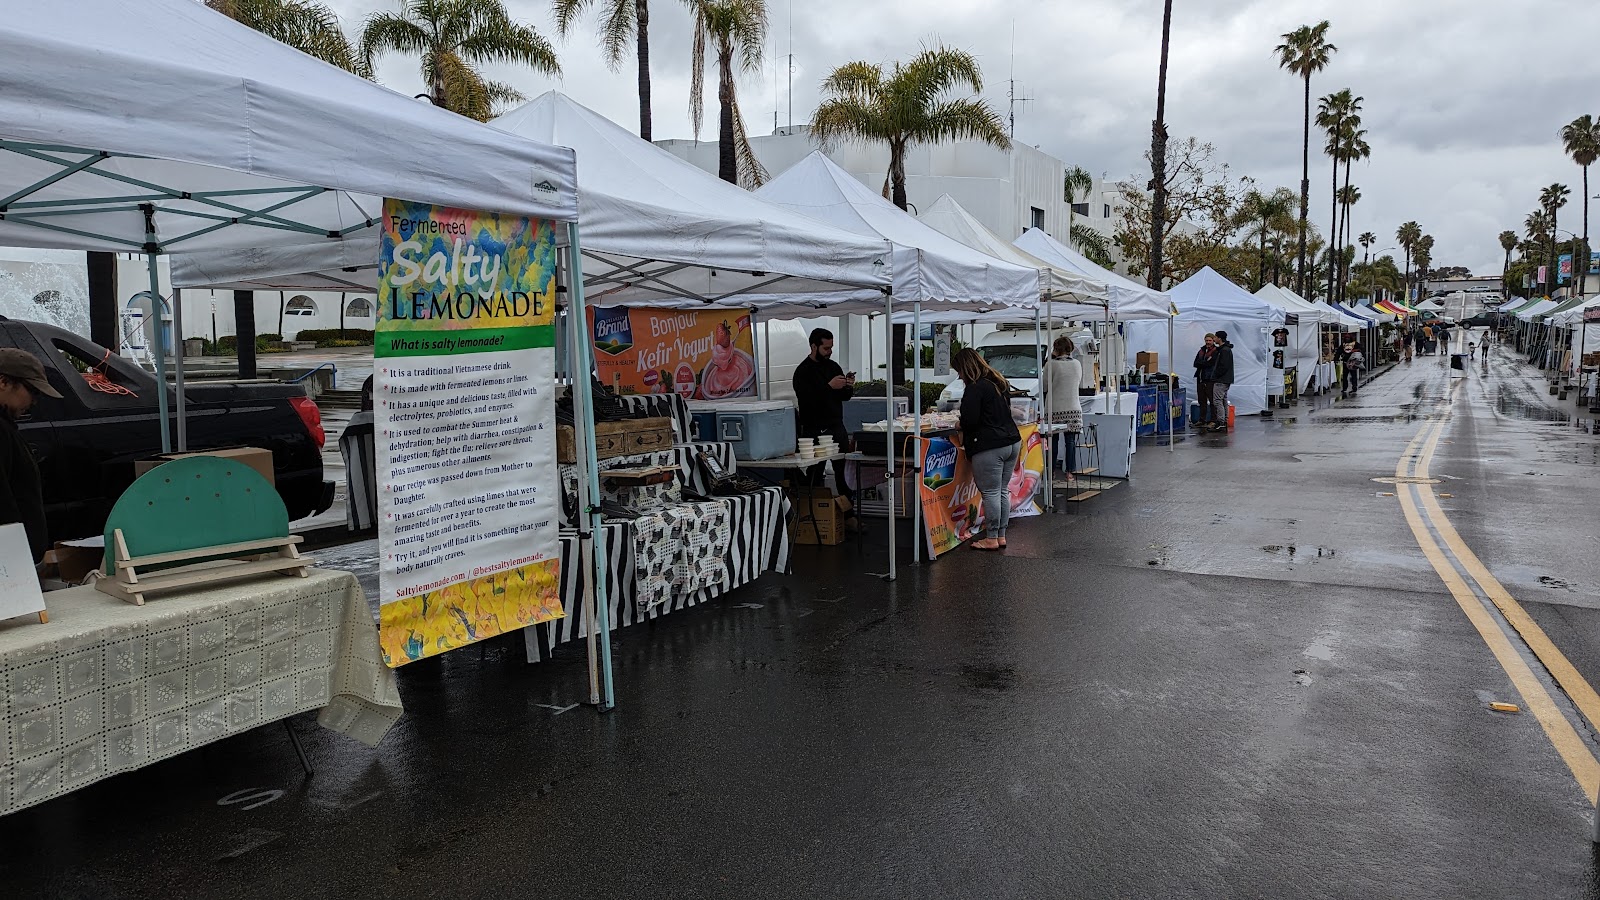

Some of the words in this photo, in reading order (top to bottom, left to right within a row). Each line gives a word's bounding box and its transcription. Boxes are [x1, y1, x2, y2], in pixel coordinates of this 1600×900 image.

[391, 216, 467, 235] Fermented
[390, 238, 500, 299] Salty
[391, 287, 542, 319] LEMONADE
[596, 316, 630, 338] Brand
[651, 312, 698, 337] Bonjour
[391, 339, 419, 350] What
[422, 338, 429, 349] is
[432, 337, 456, 351] salty
[458, 335, 504, 348] lemonade?
[637, 343, 672, 372] Kefir
[674, 331, 715, 362] Yogurt
[390, 369, 397, 378] It
[414, 366, 453, 376] traditional
[455, 363, 491, 373] Vietnamese
[493, 362, 511, 371] drink.
[391, 385, 397, 394] It
[399, 385, 406, 393] is
[408, 385, 428, 393] made
[447, 379, 481, 389] fermented
[482, 377, 505, 386] lemons
[513, 374, 528, 382] limes.
[389, 401, 395, 409] It
[397, 400, 411, 409] has
[419, 399, 444, 409] unique
[460, 393, 489, 403] delicious
[508, 389, 522, 398] filled
[522, 387, 537, 395] with
[389, 411, 435, 423] electrolytes,
[437, 407, 473, 420] probiotics,
[474, 405, 487, 413] and
[488, 402, 514, 413] enzymes.
[389, 430, 394, 439] It
[403, 427, 421, 436] used
[432, 424, 458, 433] combat
[459, 422, 470, 430] the
[472, 419, 498, 428] Summer
[389, 439, 434, 452] dehydration;
[436, 436, 452, 447] help
[453, 432, 468, 442] with
[470, 429, 500, 440] diarrhea,
[501, 424, 537, 438] constipation
[389, 452, 430, 466] indigestion;
[431, 448, 449, 459] fight
[462, 444, 474, 454] flu;
[475, 442, 498, 452] relieve
[512, 436, 533, 446] throat;
[926, 448, 956, 473] Brand
[391, 468, 406, 479] plus
[407, 462, 440, 474] numerous
[442, 459, 460, 468] other
[462, 454, 492, 464] ailments.
[393, 484, 406, 493] Our
[407, 480, 426, 491] recipe
[427, 476, 439, 484] was
[441, 471, 464, 484] passed
[465, 468, 483, 479] down
[484, 466, 500, 475] from
[501, 462, 523, 473] Mother
[394, 493, 426, 506] Daughter.
[394, 513, 400, 522] It
[402, 511, 415, 520] was
[416, 504, 442, 518] carefully
[443, 498, 466, 509] crafted
[467, 495, 486, 506] using
[487, 492, 505, 500] limes
[506, 489, 519, 497] that
[520, 486, 536, 494] were
[394, 521, 430, 533] fermented
[431, 517, 439, 526] for
[440, 513, 454, 523] over
[460, 509, 475, 520] year
[485, 504, 506, 512] create
[507, 500, 518, 508] the
[519, 497, 536, 506] most
[394, 533, 424, 546] amazing
[426, 530, 440, 539] taste
[441, 526, 452, 535] and
[453, 521, 481, 531] benefits.
[395, 553, 408, 564] Try
[419, 546, 430, 556] and
[431, 543, 442, 555] you
[443, 539, 454, 550] will
[455, 535, 469, 545] find
[484, 526, 519, 540] something
[520, 523, 533, 532] that
[534, 520, 548, 530] your
[396, 562, 413, 575] body
[415, 555, 443, 569] naturally
[445, 550, 466, 561] craves.
[396, 572, 465, 597] Saltylemonade.com
[467, 569, 470, 579] /
[473, 552, 543, 576] @bestsaltylemonade
